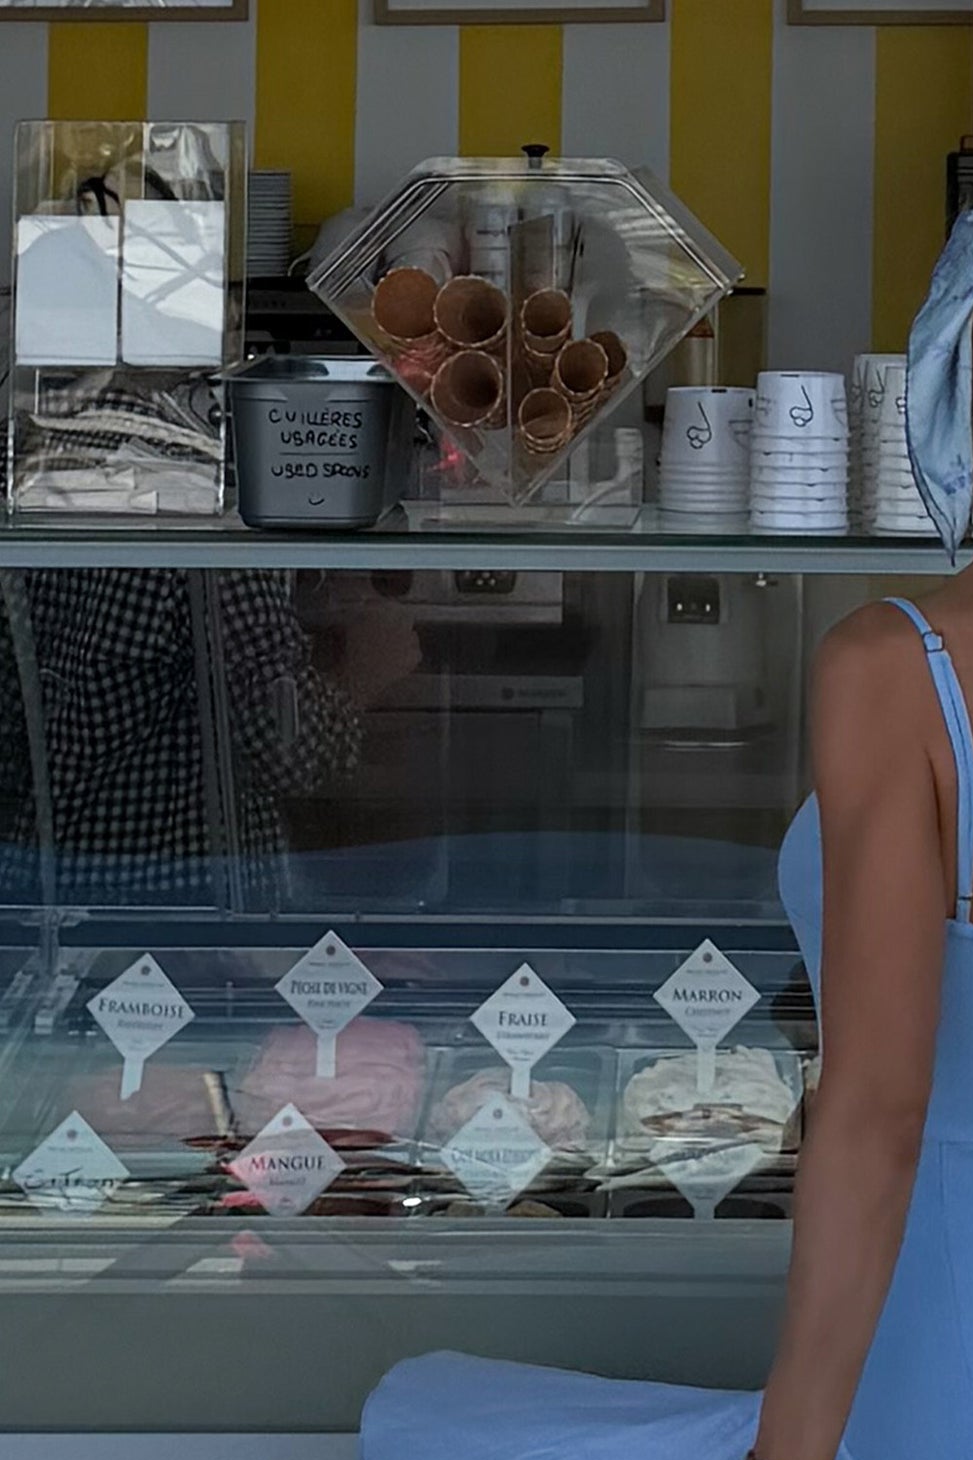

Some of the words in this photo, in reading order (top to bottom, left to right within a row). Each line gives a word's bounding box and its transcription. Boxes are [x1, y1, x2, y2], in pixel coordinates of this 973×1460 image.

[271, 462, 318, 479] USED
[672, 987, 743, 1003] MARRON
[98, 997, 184, 1019] FRAMBOISE
[498, 1010, 549, 1027] FRAISE
[247, 1154, 326, 1171] MANGUE
